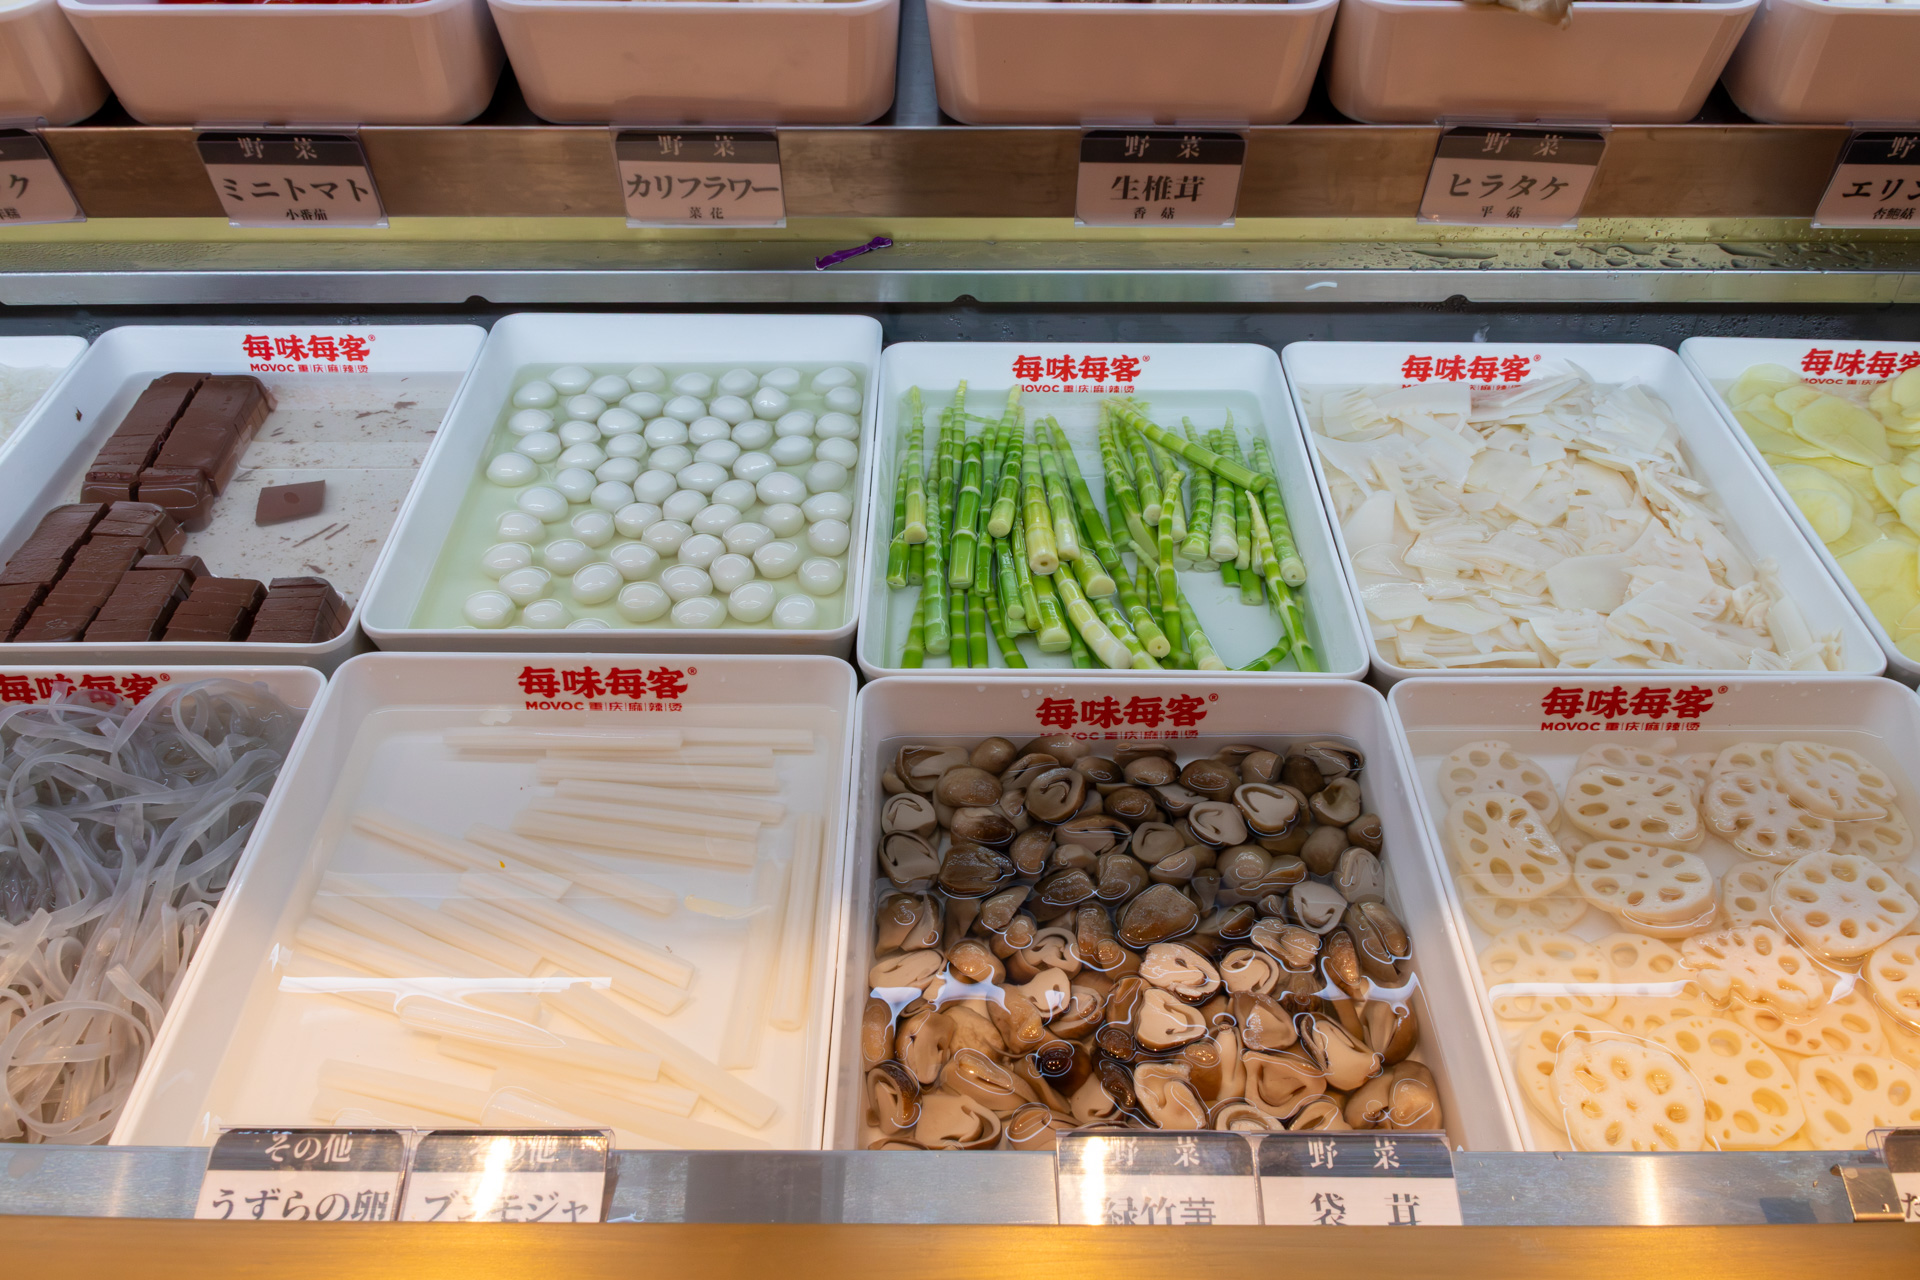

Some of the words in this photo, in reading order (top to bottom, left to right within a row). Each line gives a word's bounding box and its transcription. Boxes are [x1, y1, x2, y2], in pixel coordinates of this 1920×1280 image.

[237, 137, 318, 160] 野菜
[657, 135, 735, 158] 野菜
[1124, 135, 1202, 159] 野菜
[1482, 132, 1563, 157] 野菜
[223, 177, 369, 202] ミニトマト
[626, 174, 779, 200] カリフラワー
[1110, 175, 1206, 202] 生椎茸
[1449, 173, 1569, 201] ヒラタケ
[285, 208, 328, 221] 小番茄
[689, 206, 724, 220] 菜花
[1133, 206, 1175, 220] 香菇
[1481, 205, 1523, 219] 平菇
[250, 363, 295, 372] MOVOC
[525, 701, 584, 711] MOVOC
[1541, 722, 1600, 731] MOVOC
[265, 1134, 353, 1163] その他
[1308, 1137, 1400, 1170] 野菜
[213, 1188, 390, 1220] うずらの卵
